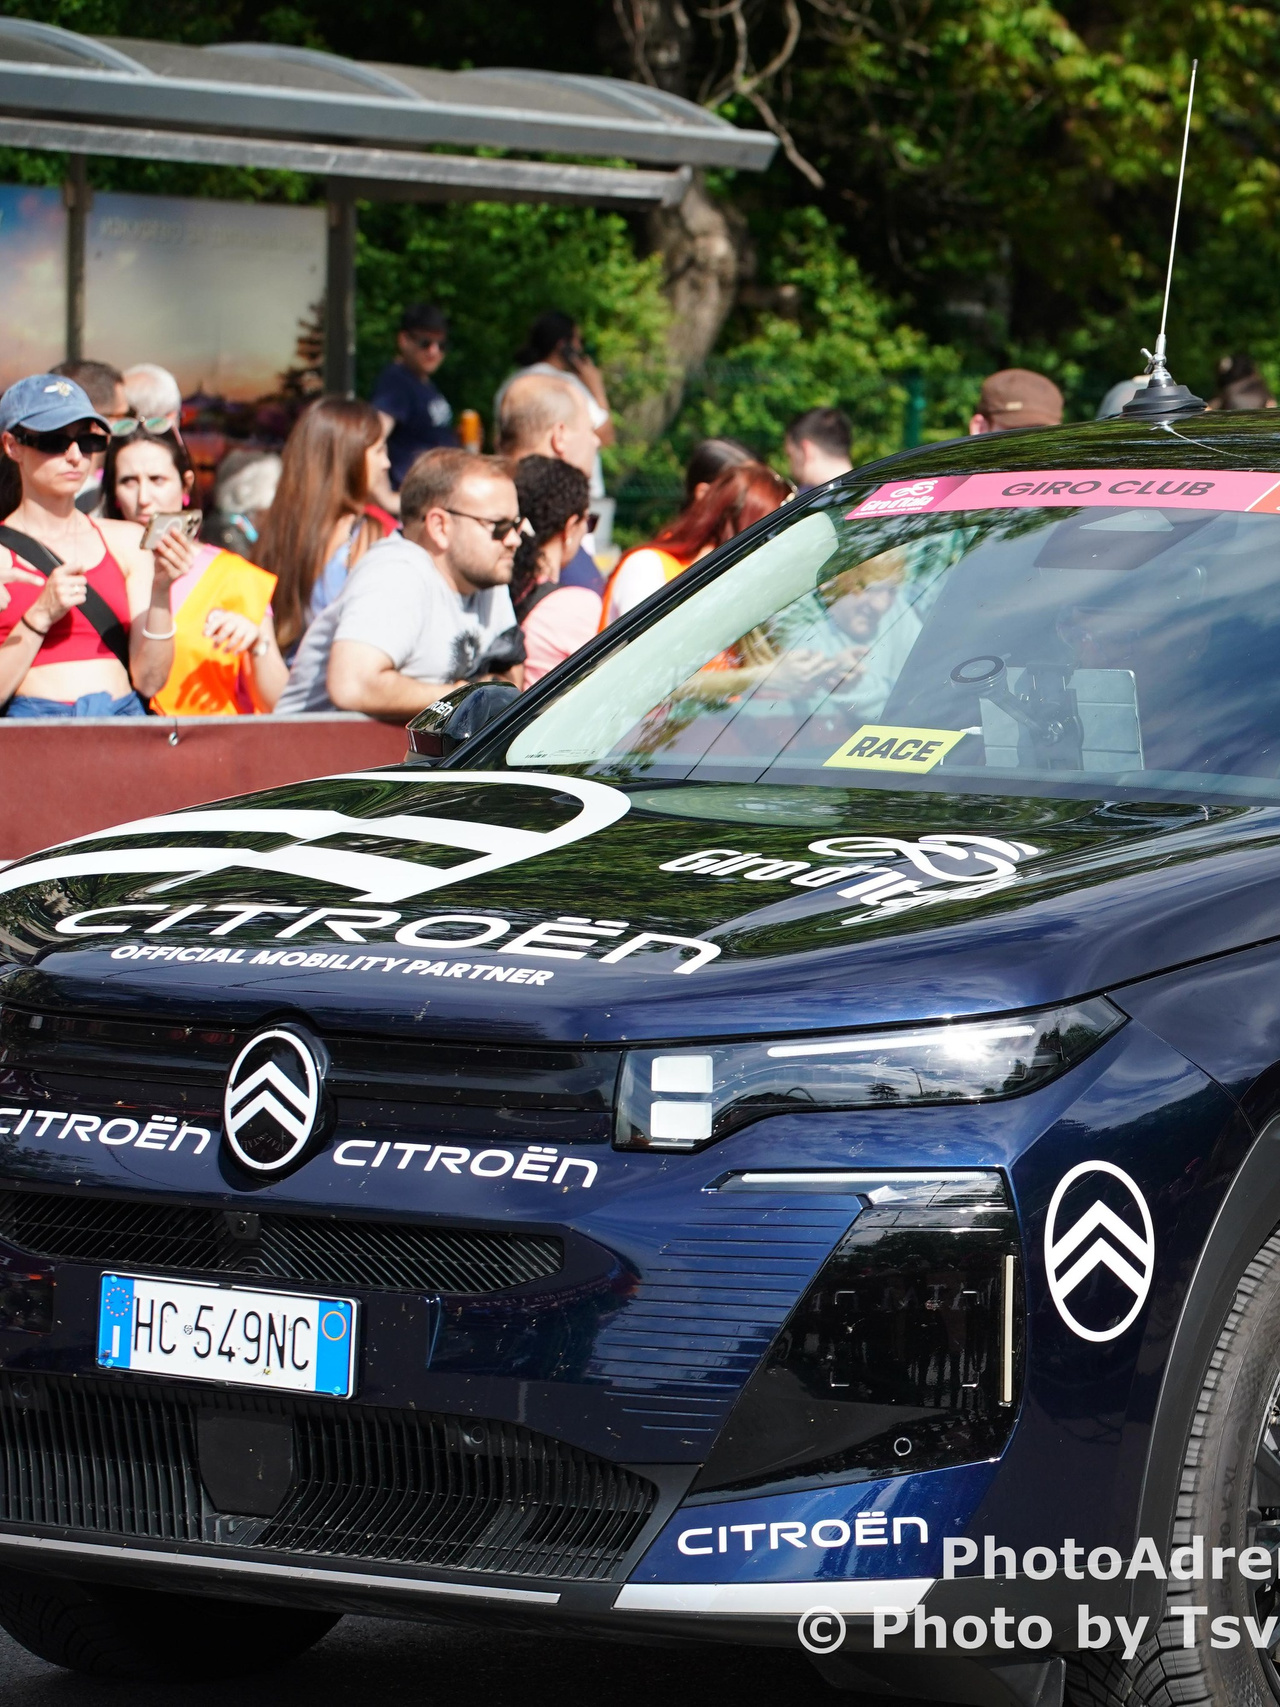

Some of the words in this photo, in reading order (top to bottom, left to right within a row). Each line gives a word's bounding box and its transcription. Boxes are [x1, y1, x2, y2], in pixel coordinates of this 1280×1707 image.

[1001, 480, 1103, 497] GIRO
[1108, 480, 1216, 497] CLUB
[846, 736, 944, 762] RACE
[658, 848, 812, 881] Giro
[111, 944, 246, 965] OFFICIAL
[249, 950, 405, 976] MOBILITY
[403, 958, 555, 987] PARTNER
